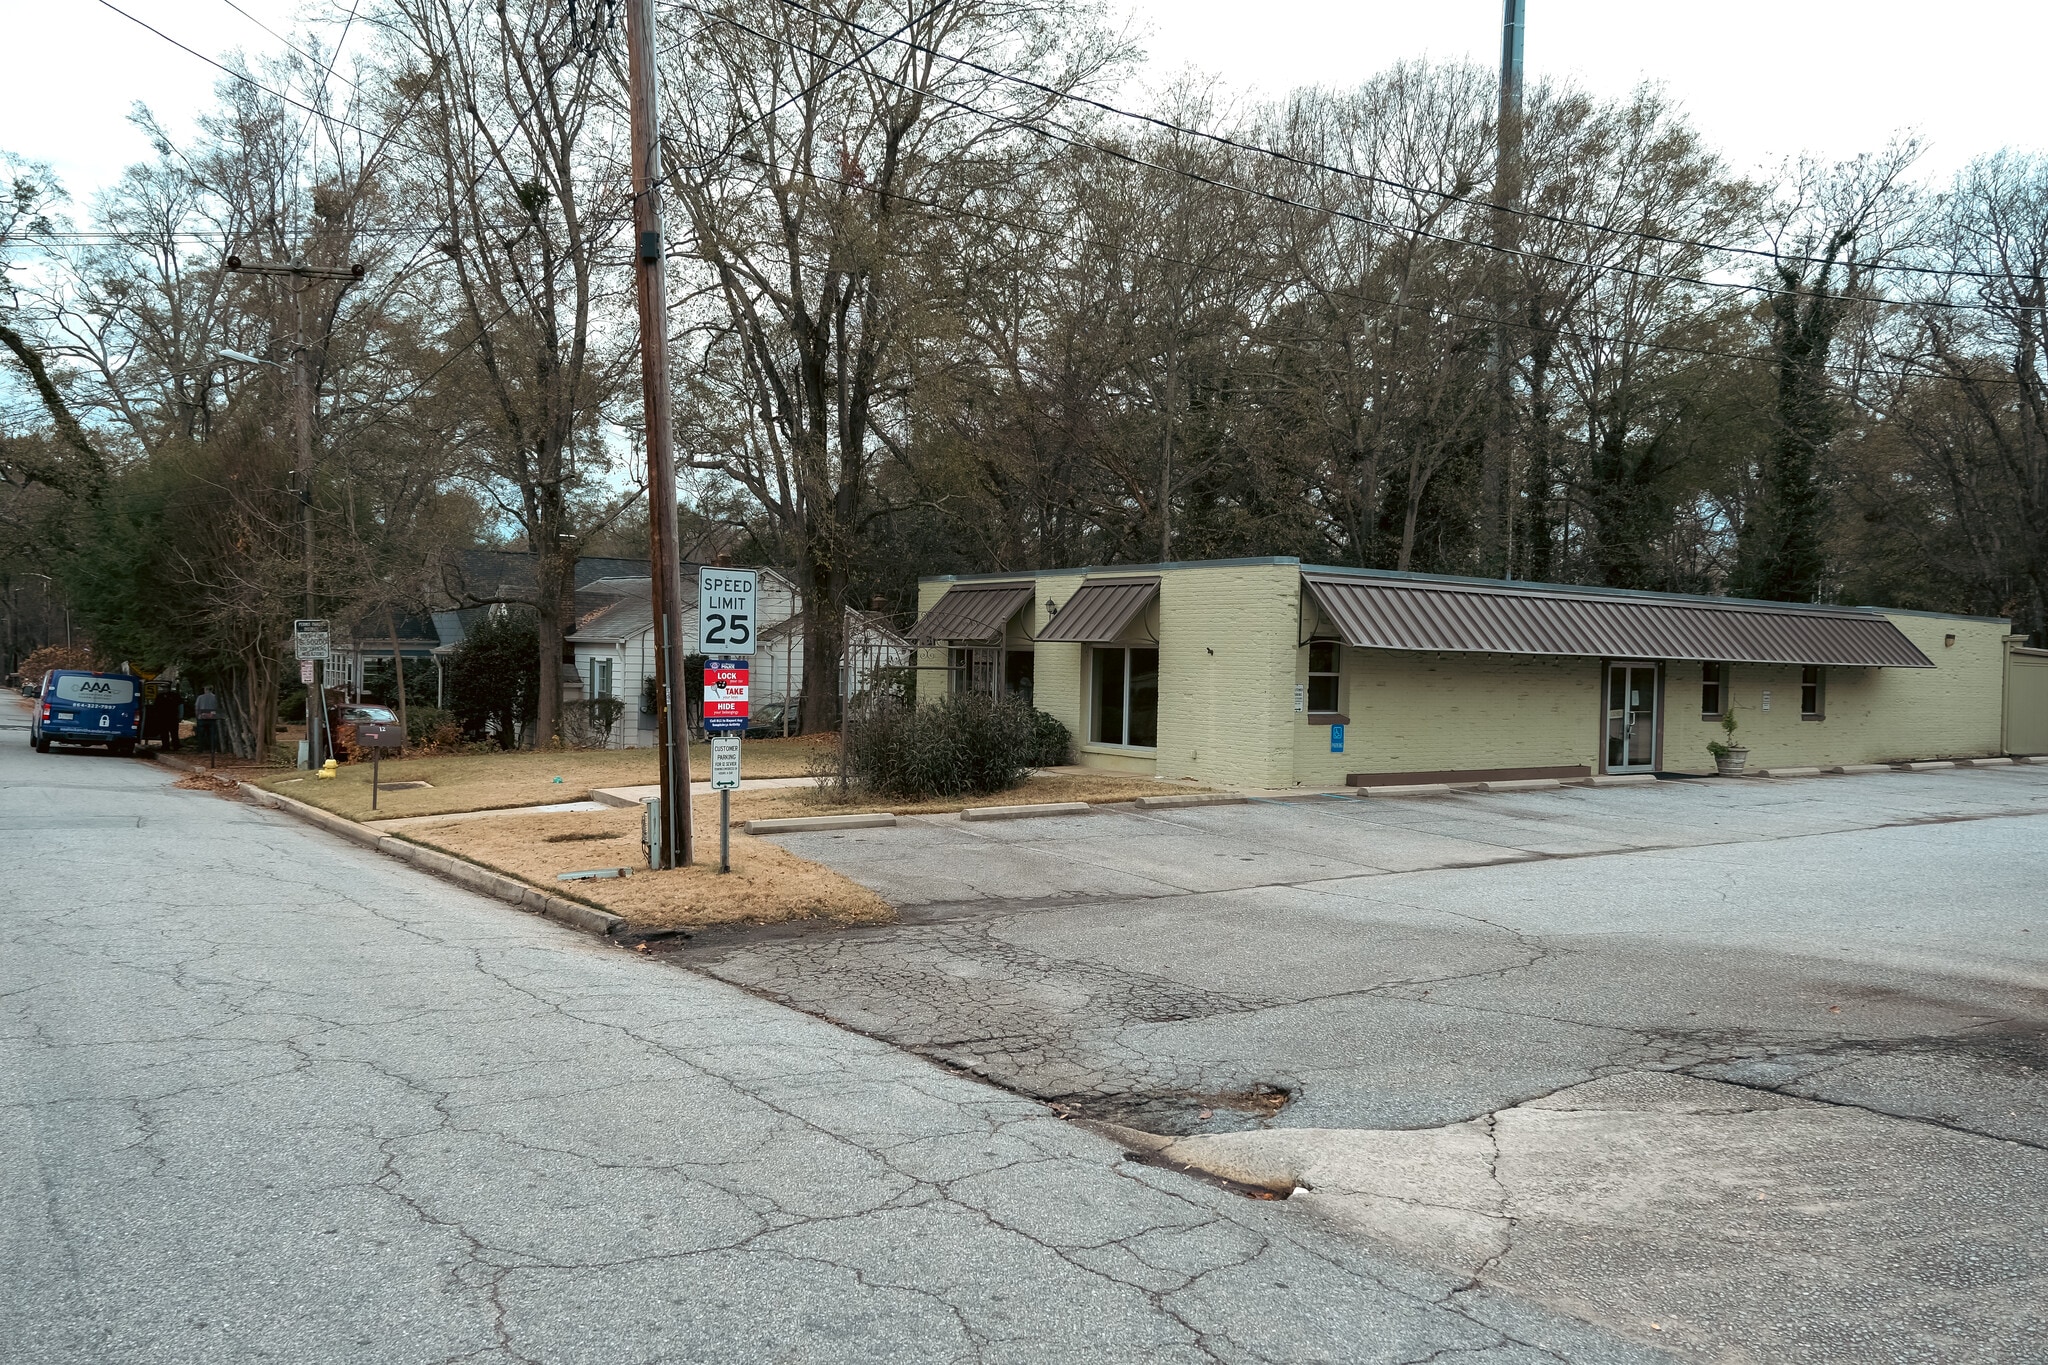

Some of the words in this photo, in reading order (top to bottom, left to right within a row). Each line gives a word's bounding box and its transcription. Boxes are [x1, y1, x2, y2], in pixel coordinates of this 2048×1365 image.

[704, 578, 752, 593] SPEED
[709, 596, 746, 610] LIMIT
[705, 613, 750, 645] 25
[717, 672, 737, 680] LOCK
[80, 682, 112, 693] AAA
